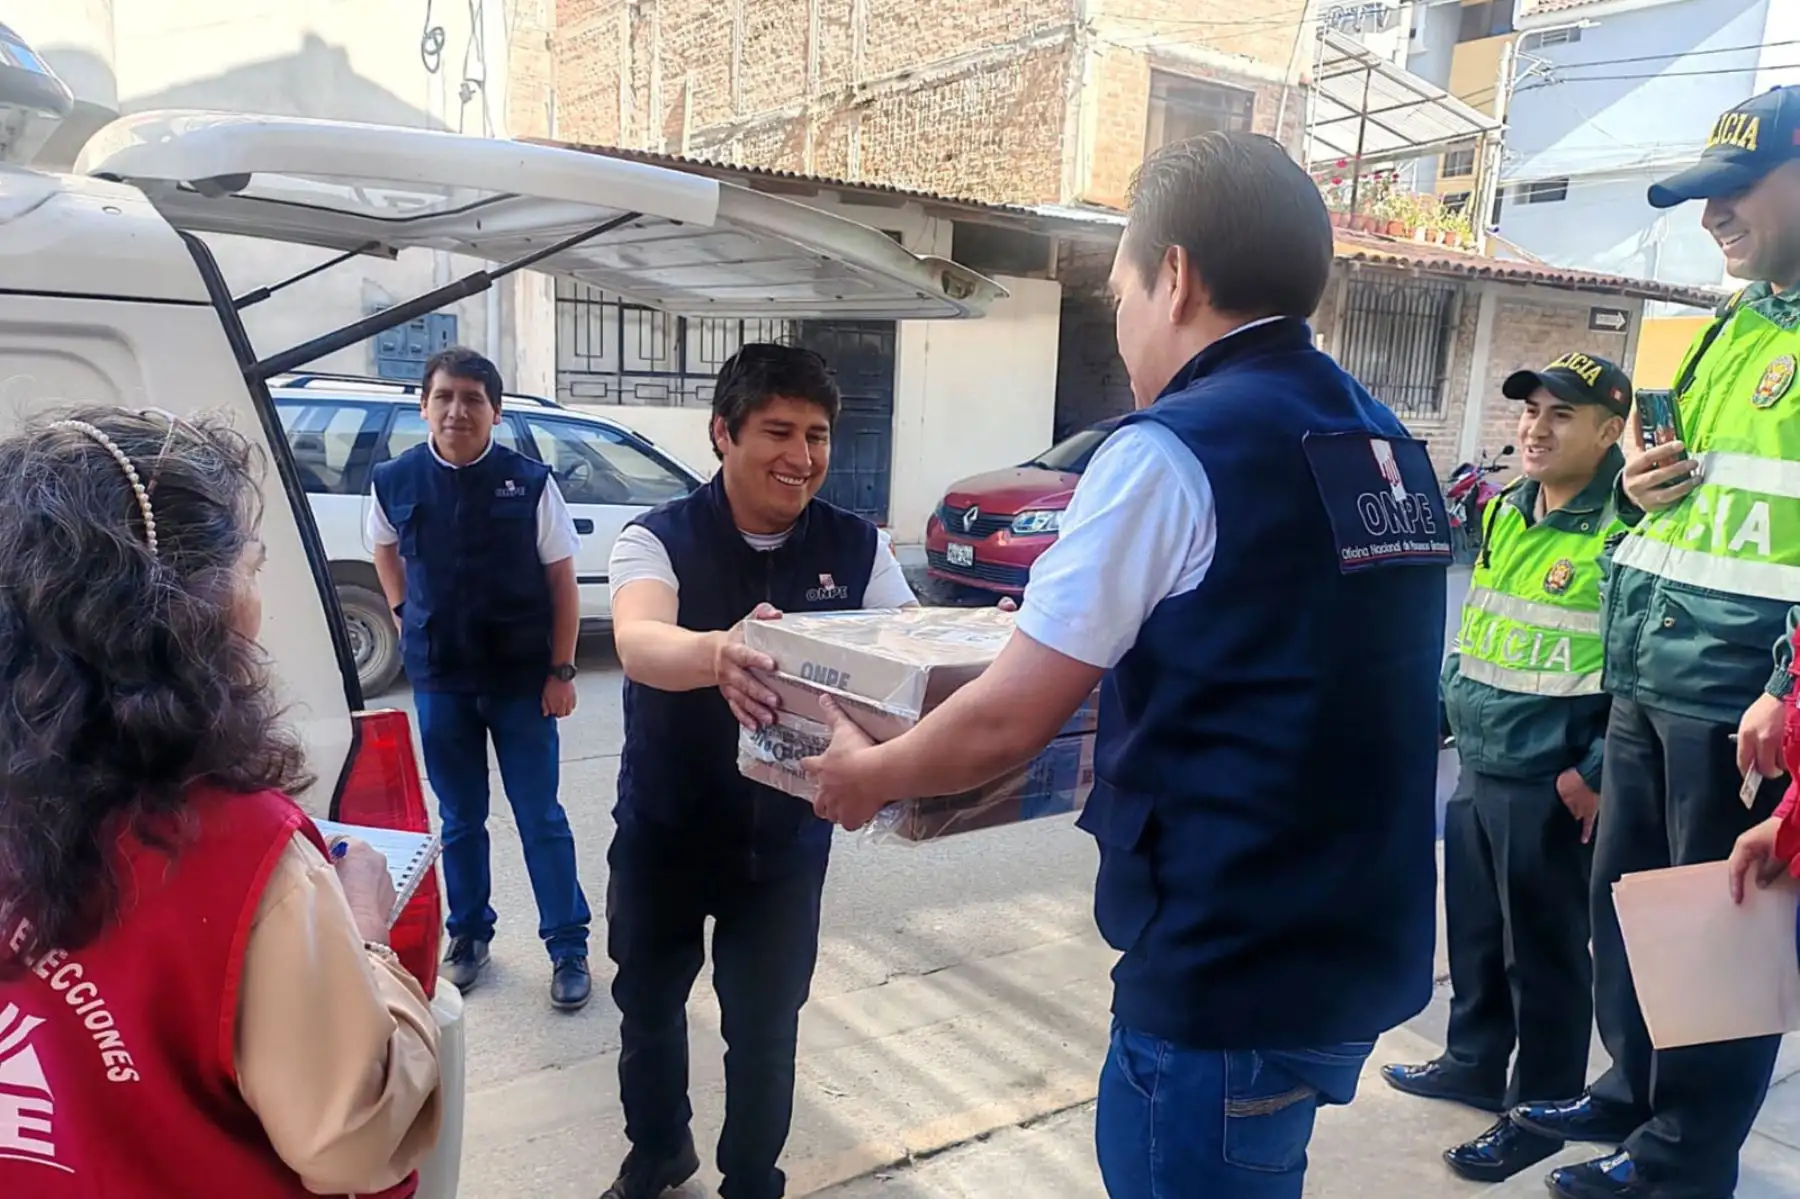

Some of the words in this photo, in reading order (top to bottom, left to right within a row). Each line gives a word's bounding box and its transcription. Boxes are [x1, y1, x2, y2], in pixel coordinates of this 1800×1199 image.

[1357, 491, 1436, 536] ONPE
[1370, 540, 1401, 556] Nacional
[806, 585, 848, 602] ONPE
[801, 662, 851, 690] ONPE
